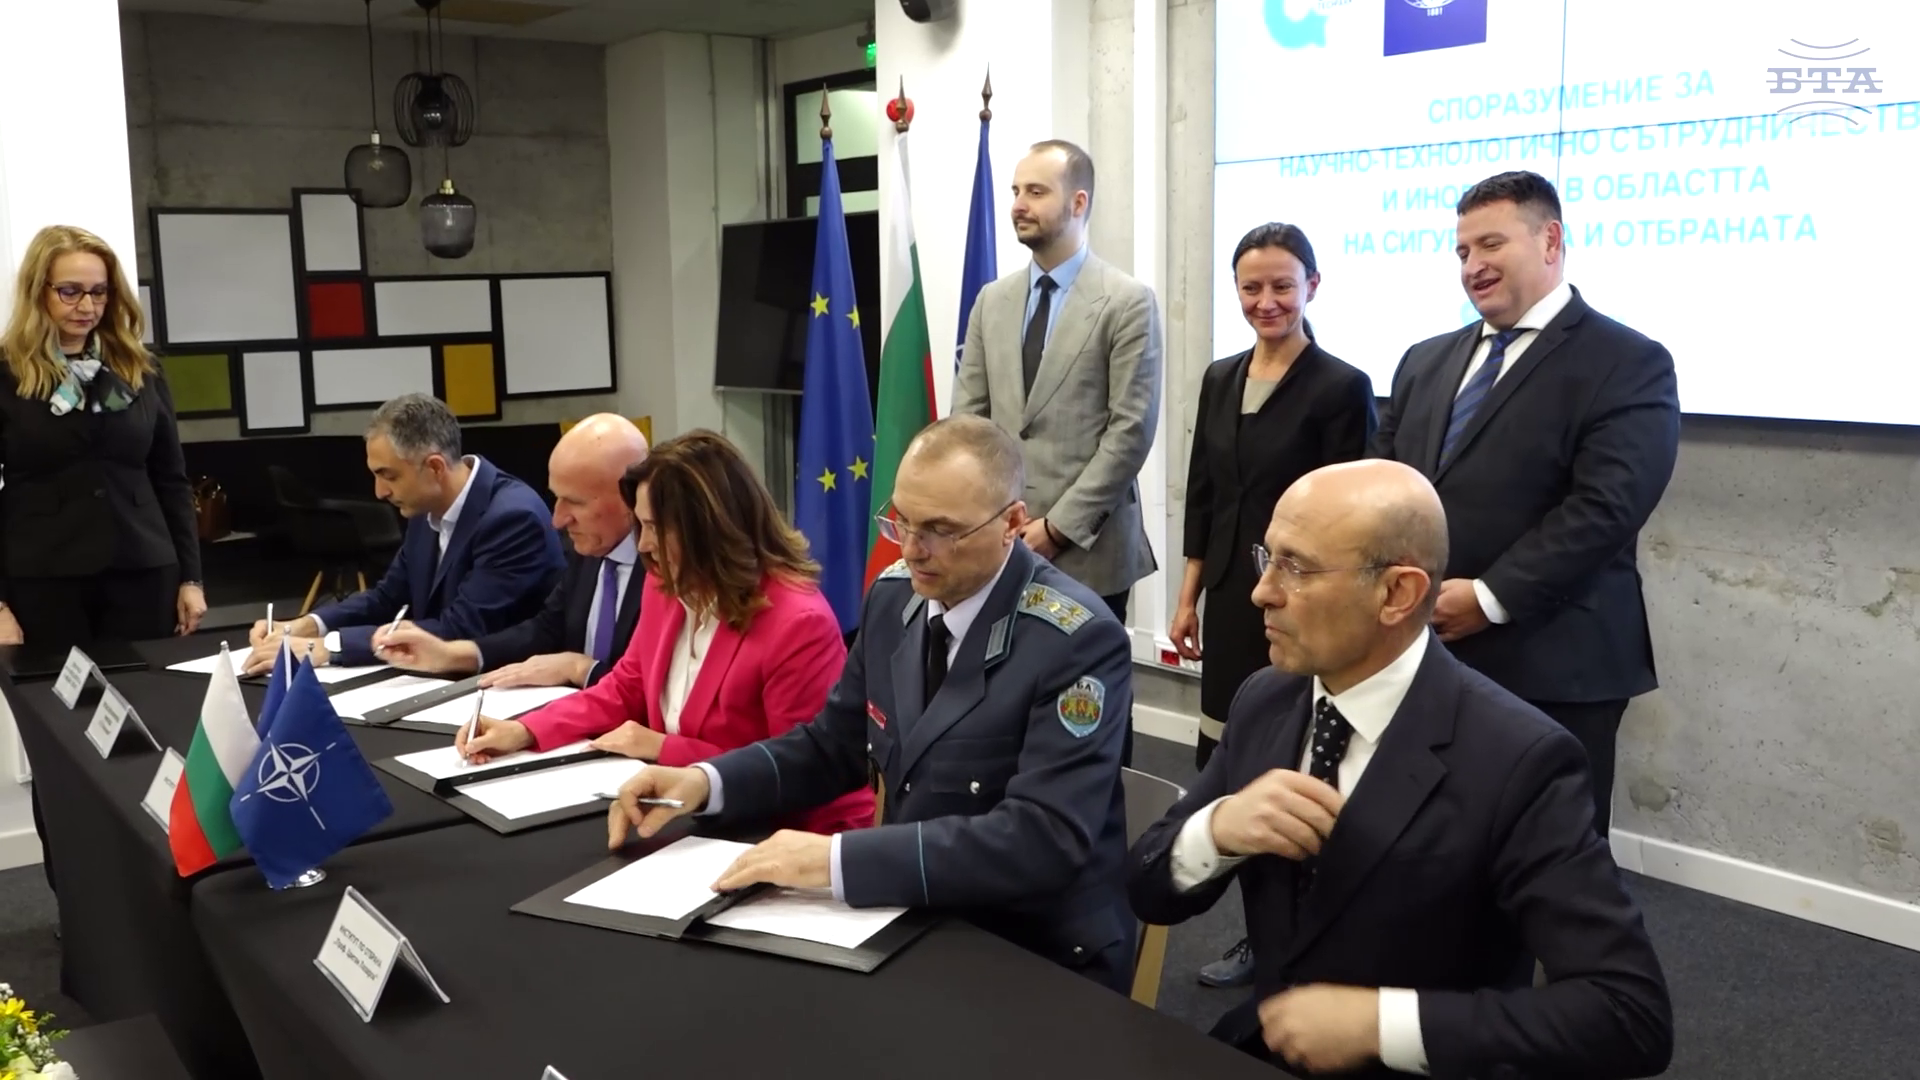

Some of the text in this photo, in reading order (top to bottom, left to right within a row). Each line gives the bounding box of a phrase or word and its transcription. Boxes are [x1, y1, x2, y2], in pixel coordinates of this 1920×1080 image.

[1428, 70, 1715, 124] СПОРАЗУМЕНИЕ ЗА
[1382, 189, 1398, 212] И
[1566, 176, 1584, 202] В
[1593, 164, 1771, 202] ОБЛАСТТА
[1344, 231, 1376, 255] НА
[1584, 221, 1604, 248] И
[1613, 212, 1817, 248] ОТБРАНАТА
